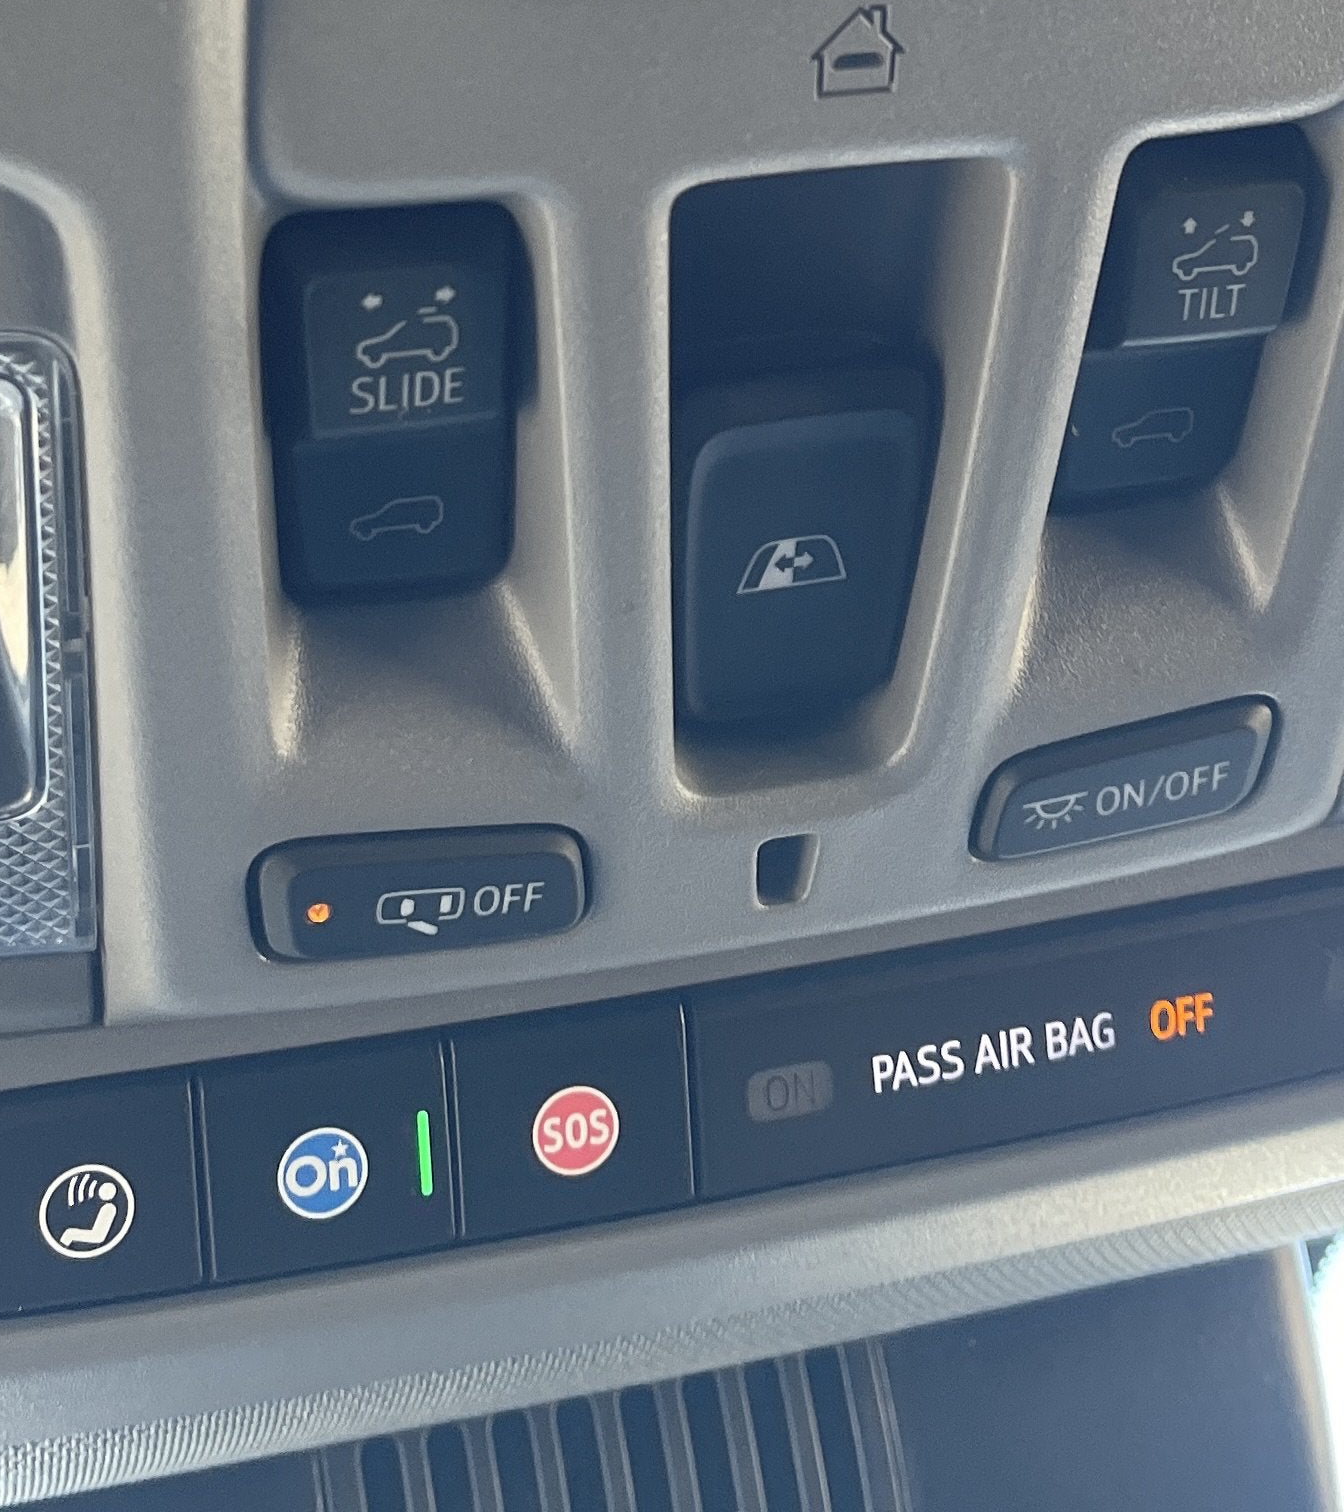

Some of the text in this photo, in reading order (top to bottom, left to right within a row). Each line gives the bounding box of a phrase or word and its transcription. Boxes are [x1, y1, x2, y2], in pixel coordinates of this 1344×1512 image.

[1178, 283, 1248, 321] TILT
[349, 366, 465, 415] SLIDE
[1095, 760, 1231, 817] ON/OFF
[473, 881, 545, 917] OFF
[870, 1039, 965, 1093] PASS
[974, 1025, 1035, 1075] AIR
[1044, 1011, 1117, 1061] BAG
[1148, 991, 1215, 1041] OFF
[542, 1107, 612, 1154] SOS
[284, 1152, 359, 1199] On
